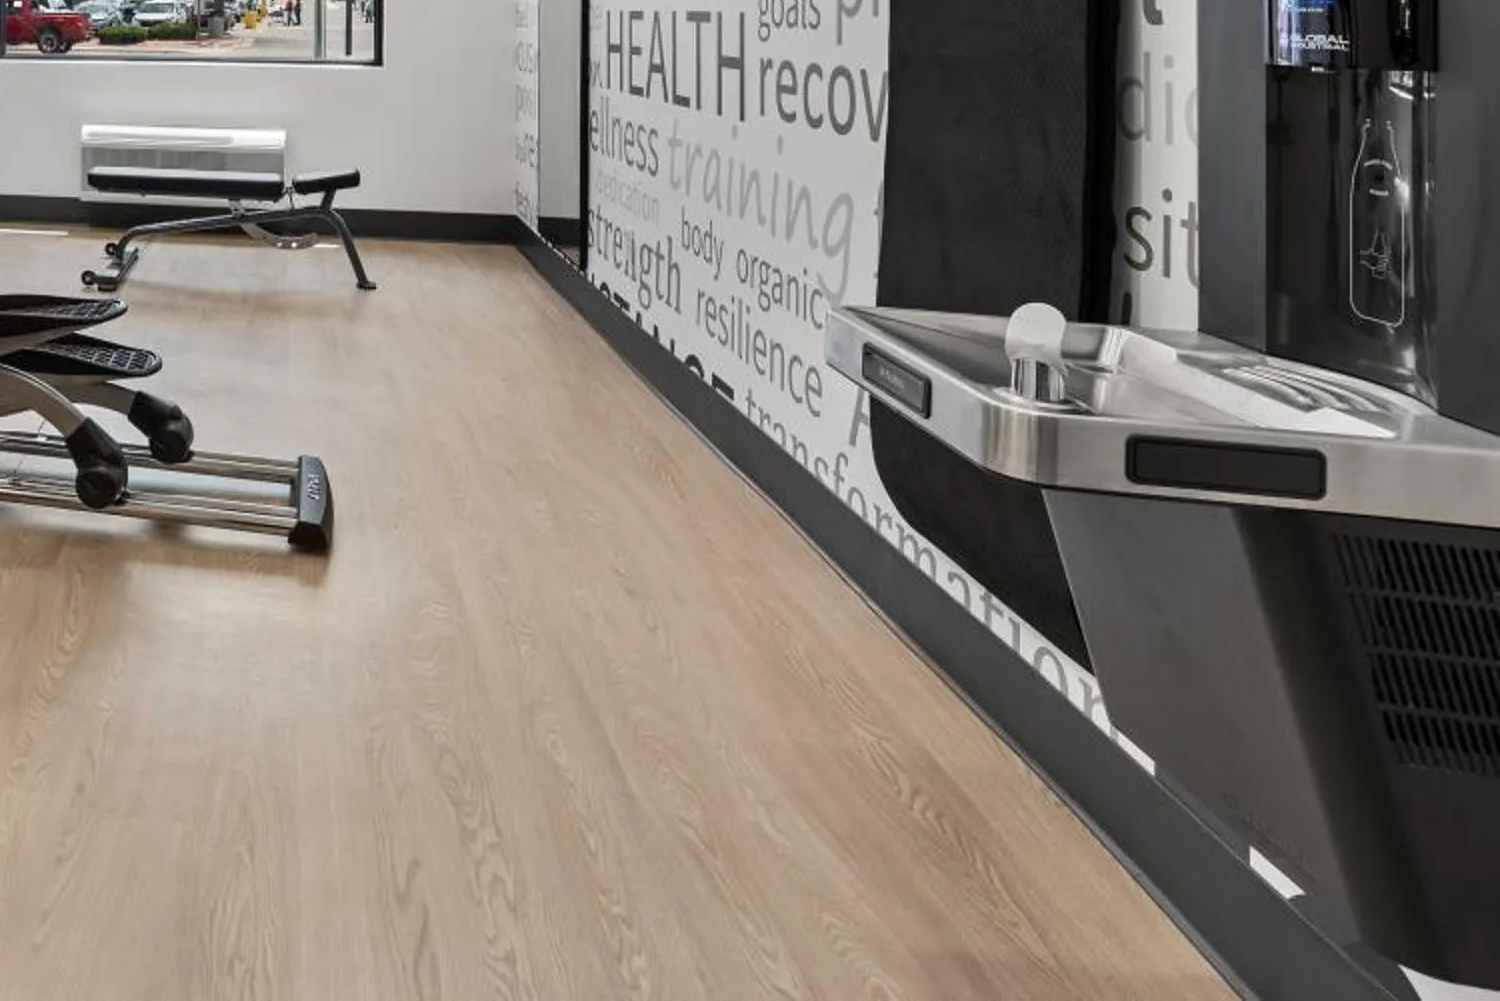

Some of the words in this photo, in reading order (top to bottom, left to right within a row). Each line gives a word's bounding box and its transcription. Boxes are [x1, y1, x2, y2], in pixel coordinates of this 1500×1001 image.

[606, 11, 745, 122] HEALTH
[760, 57, 889, 142] recov
[590, 96, 659, 177] ellness
[668, 118, 855, 307] training
[681, 207, 724, 281] body
[588, 207, 682, 315] strength
[736, 249, 824, 330] organic
[696, 287, 823, 417] resilience
